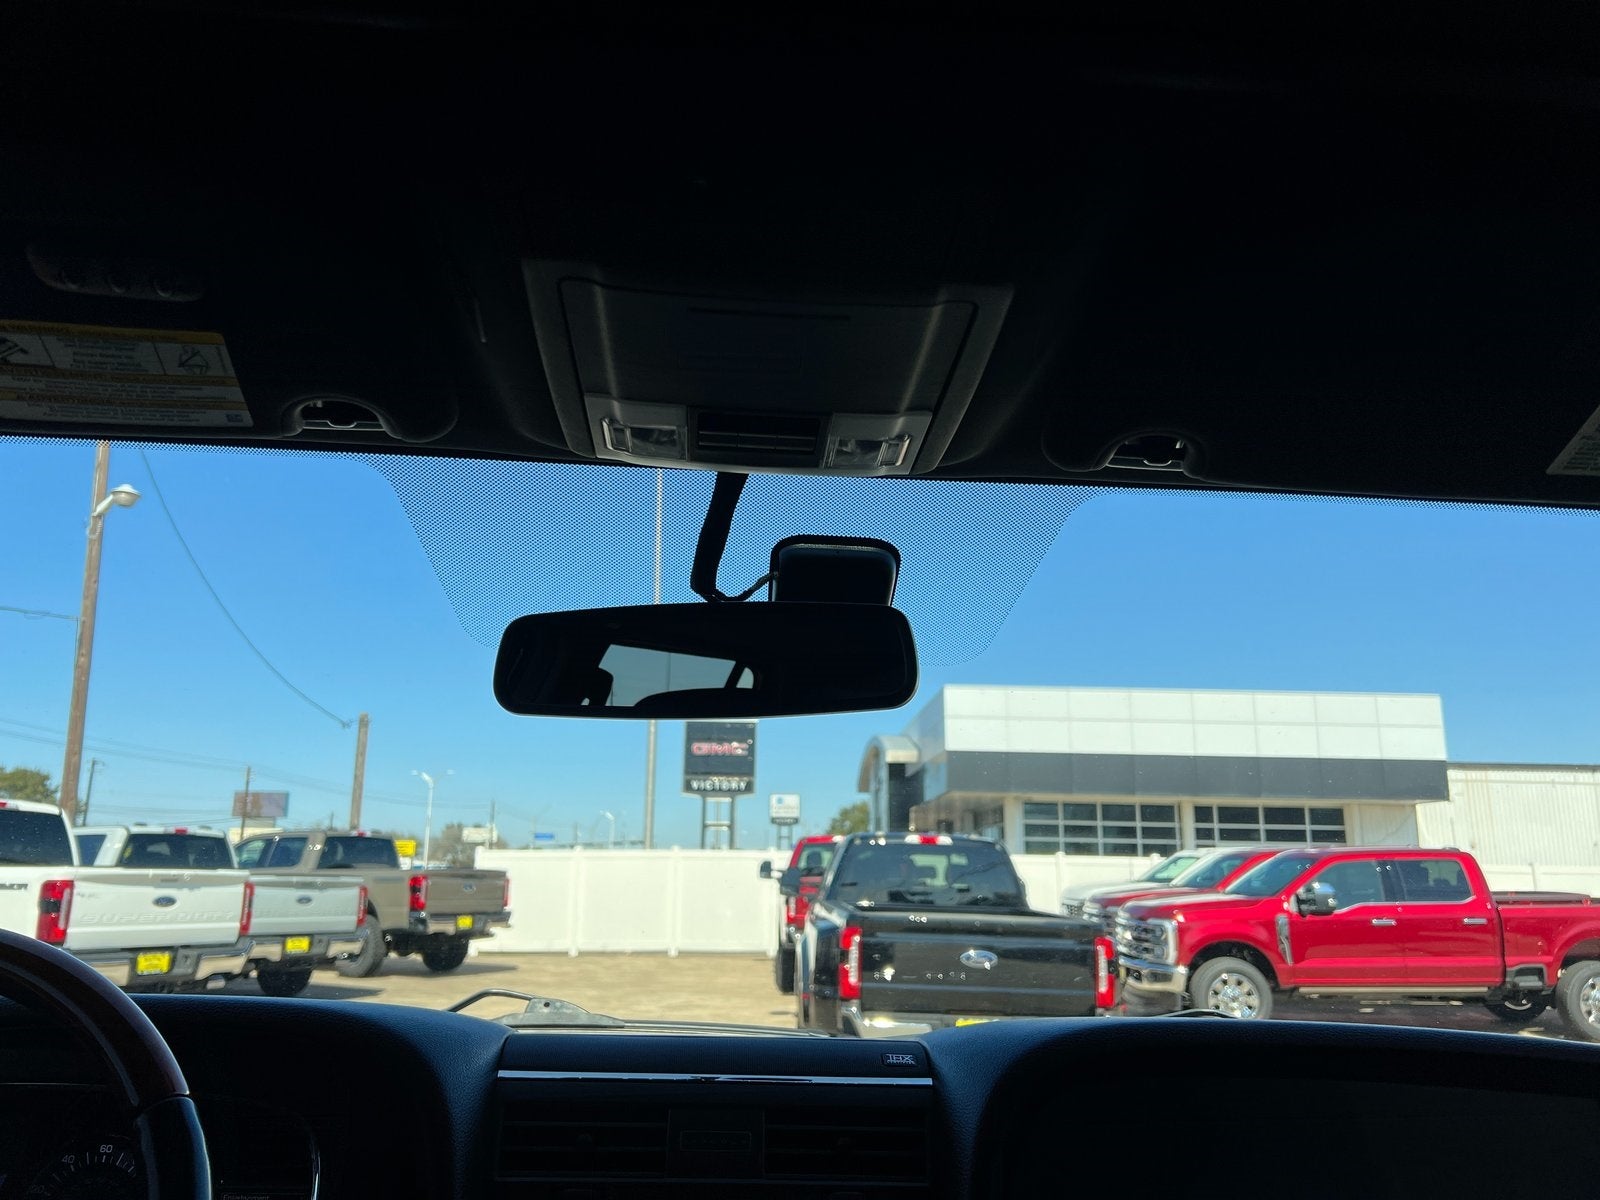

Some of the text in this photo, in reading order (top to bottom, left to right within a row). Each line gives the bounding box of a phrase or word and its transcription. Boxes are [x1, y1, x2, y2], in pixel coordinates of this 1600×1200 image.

[691, 742, 749, 756] GMC
[690, 779, 747, 791] VICTORY
[100, 1145, 113, 1153] 60
[62, 1155, 76, 1164] 40
